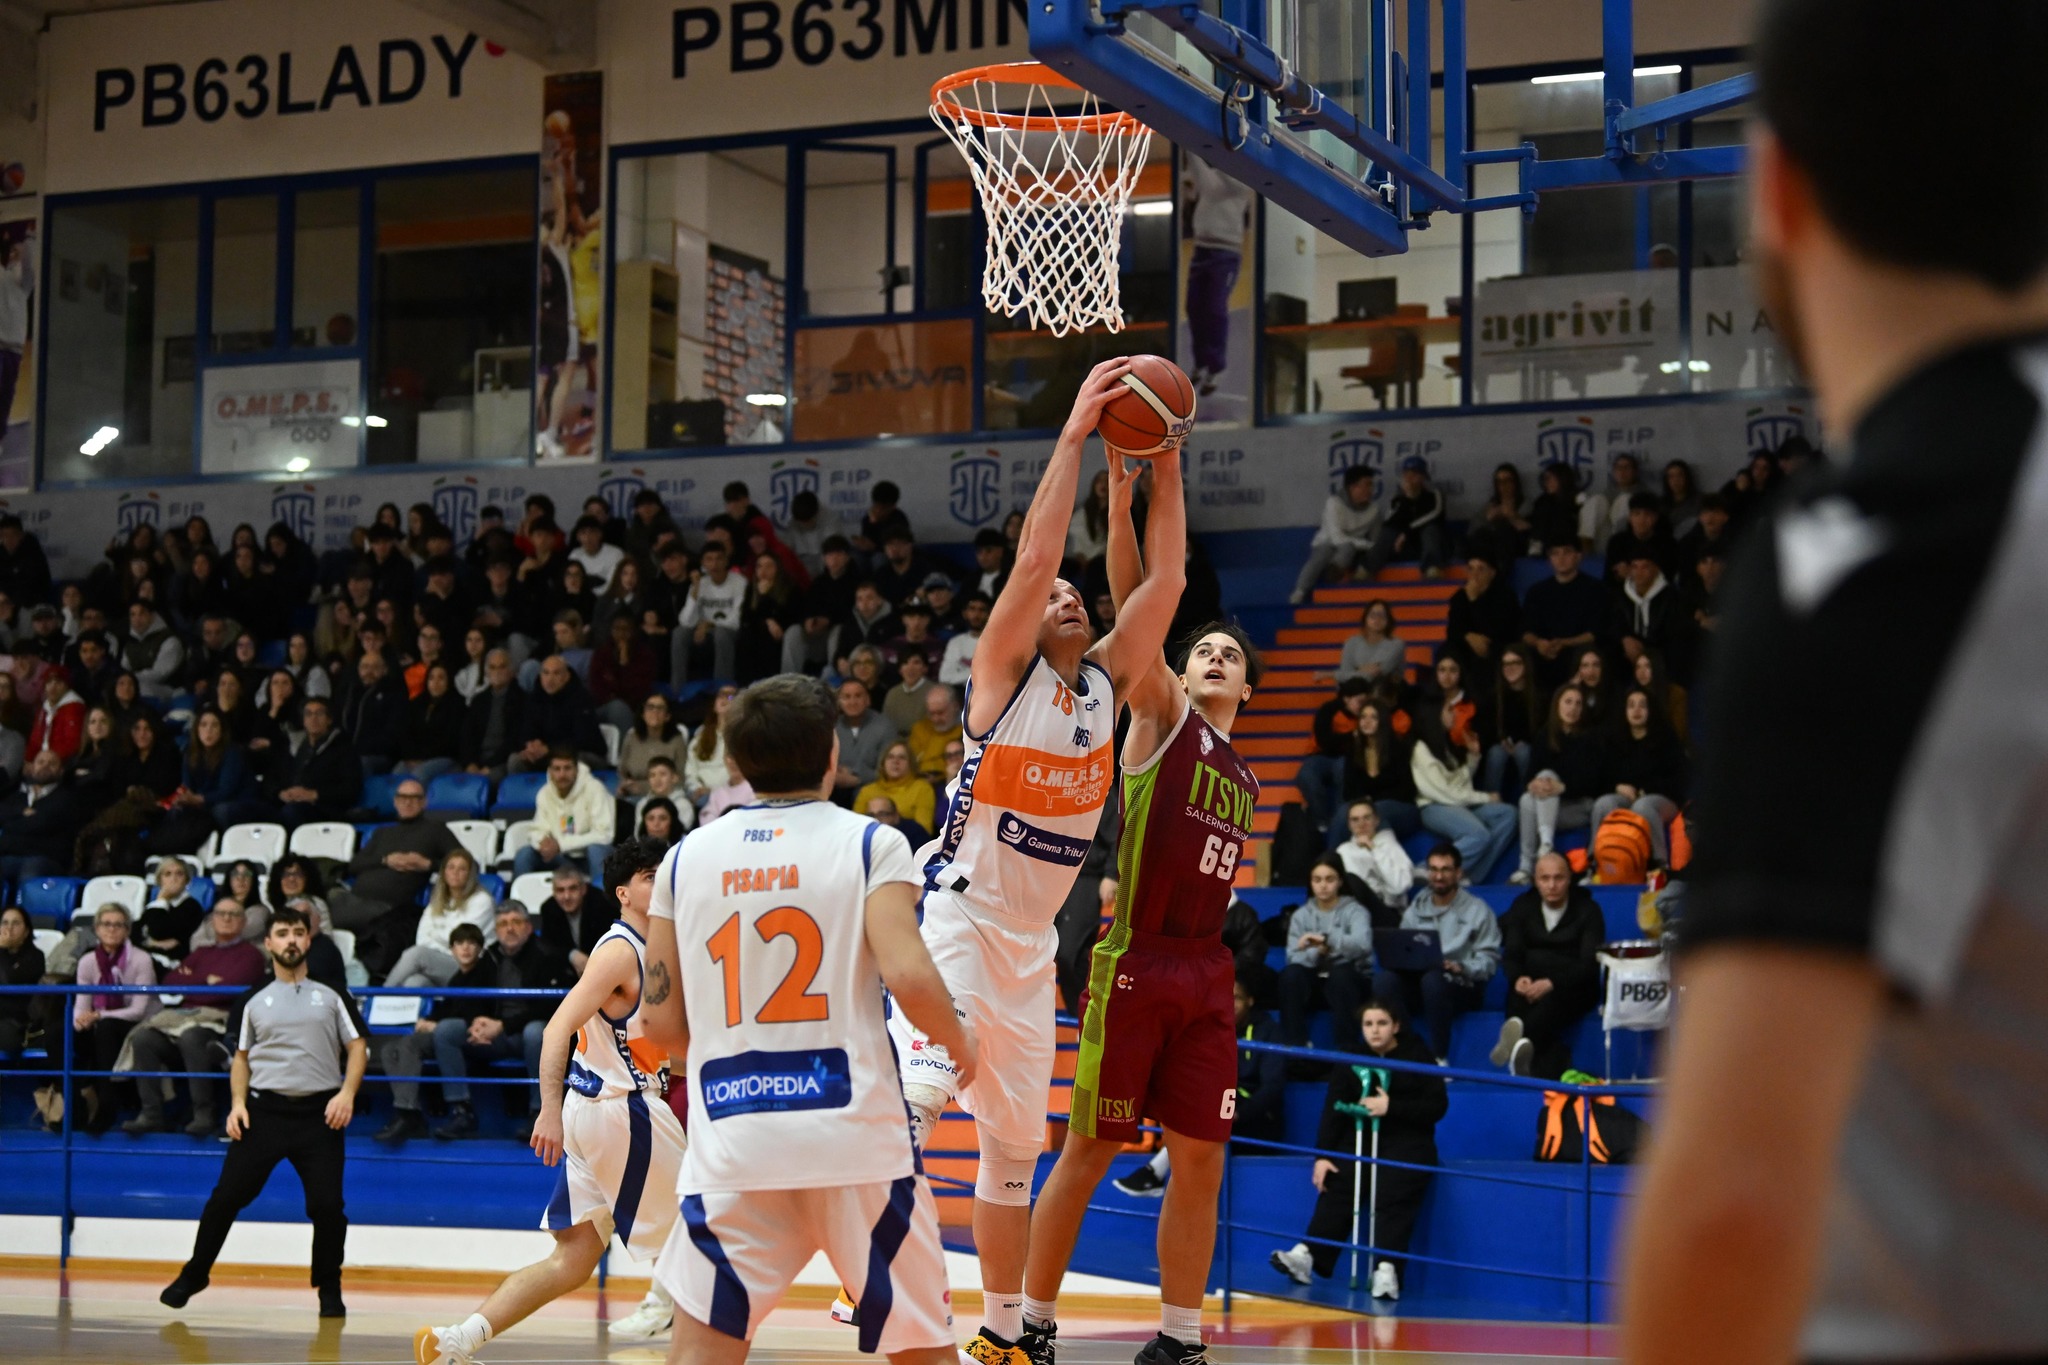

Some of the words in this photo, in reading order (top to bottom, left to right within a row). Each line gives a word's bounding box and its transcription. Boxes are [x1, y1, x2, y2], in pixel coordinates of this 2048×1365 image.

[94, 31, 478, 132] PB63LADY
[1481, 296, 1655, 348] agrivit
[1608, 427, 1655, 445] FIP
[1396, 440, 1442, 456] FIP
[1200, 449, 1245, 466] FIP
[829, 469, 873, 486] FIP
[487, 486, 526, 501] FIP
[655, 479, 696, 495] FIP
[168, 502, 205, 518] FIP
[324, 494, 362, 509] FIP
[18, 508, 52, 523] FIP
[1071, 725, 1091, 748] PB6
[1184, 805, 1231, 834] SALERNO
[743, 829, 773, 842] PB63
[1027, 836, 1062, 854] Gamma
[1199, 834, 1239, 881] 69
[721, 864, 800, 897] PISAPIA
[705, 905, 830, 1028] 12
[1620, 981, 1668, 1002] PB63
[706, 1074, 821, 1106] L'ORTOPEDIA
[1003, 1301, 1023, 1309] GIV
